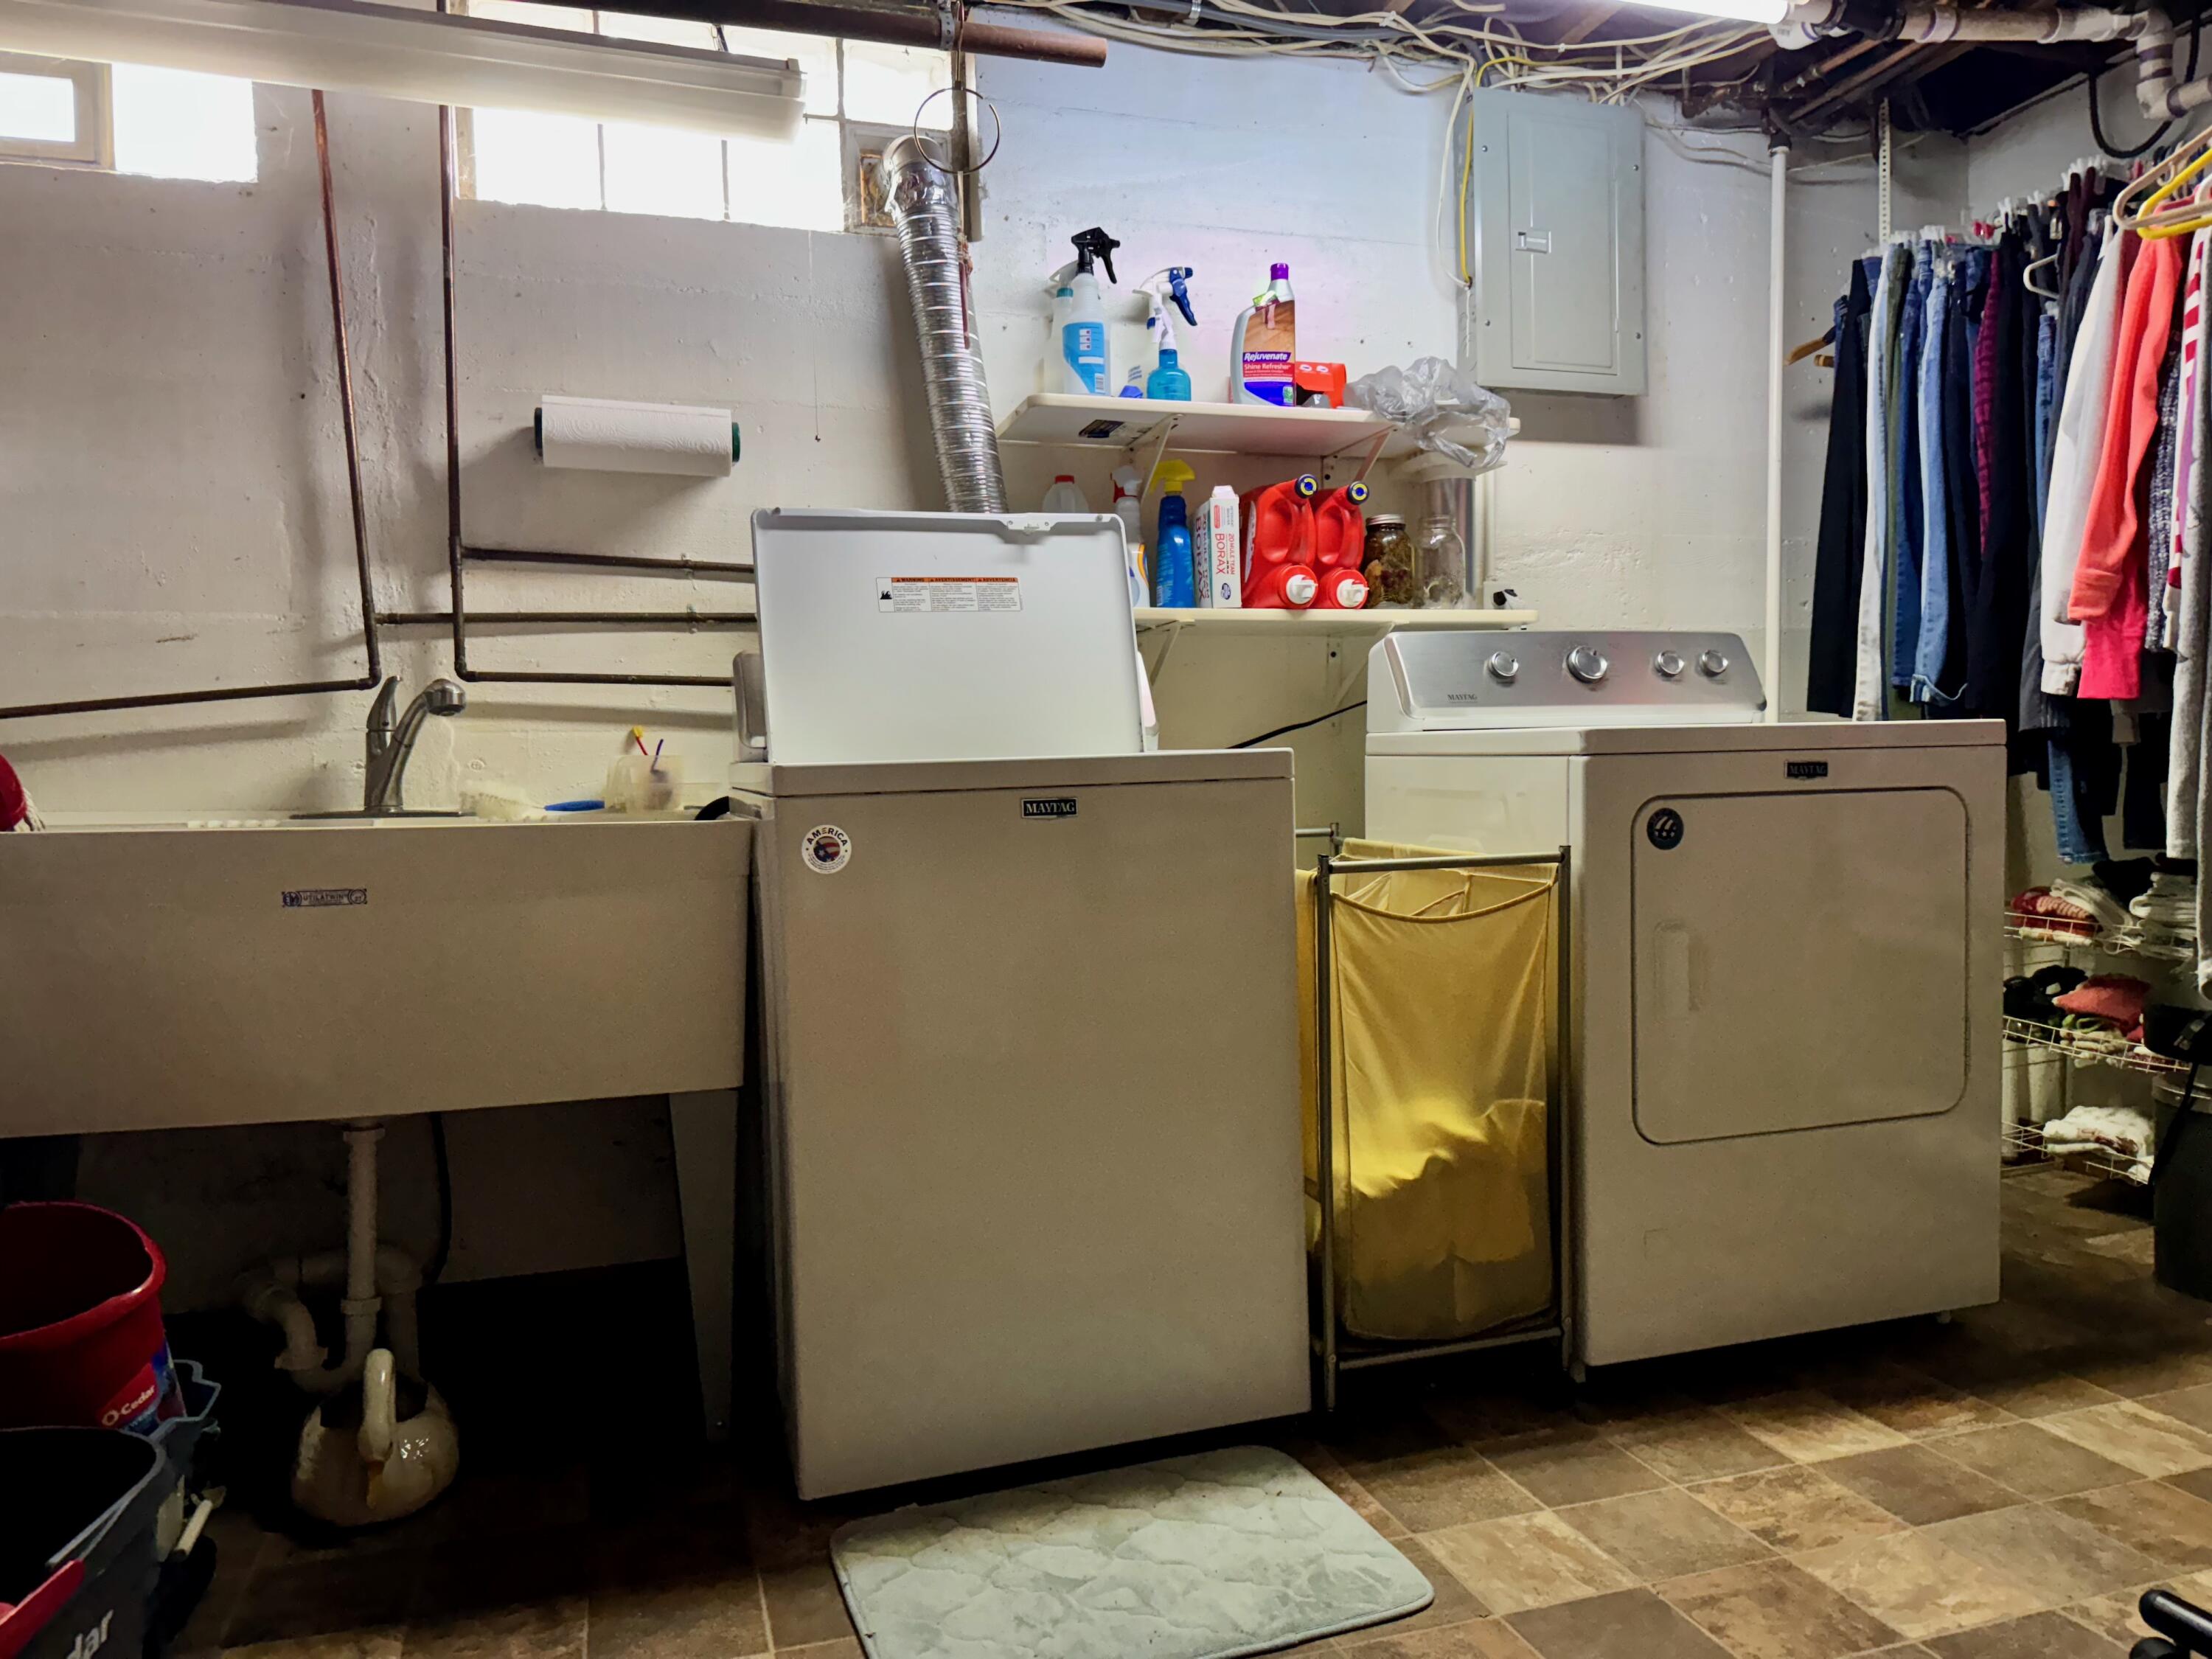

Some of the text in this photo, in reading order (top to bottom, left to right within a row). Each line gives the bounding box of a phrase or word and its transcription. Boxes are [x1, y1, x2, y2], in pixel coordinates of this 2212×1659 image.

[1244, 352, 1288, 362] Rejuvenate
[1228, 533, 1234, 542] 20
[1195, 518, 1204, 602] BORAX
[1215, 533, 1225, 574] BORAX
[1790, 765, 1826, 774] MAYTAG
[1026, 801, 1075, 814] MAYTAG
[807, 827, 849, 846] AMERICA
[102, 1385, 156, 1426] O-Cedar
